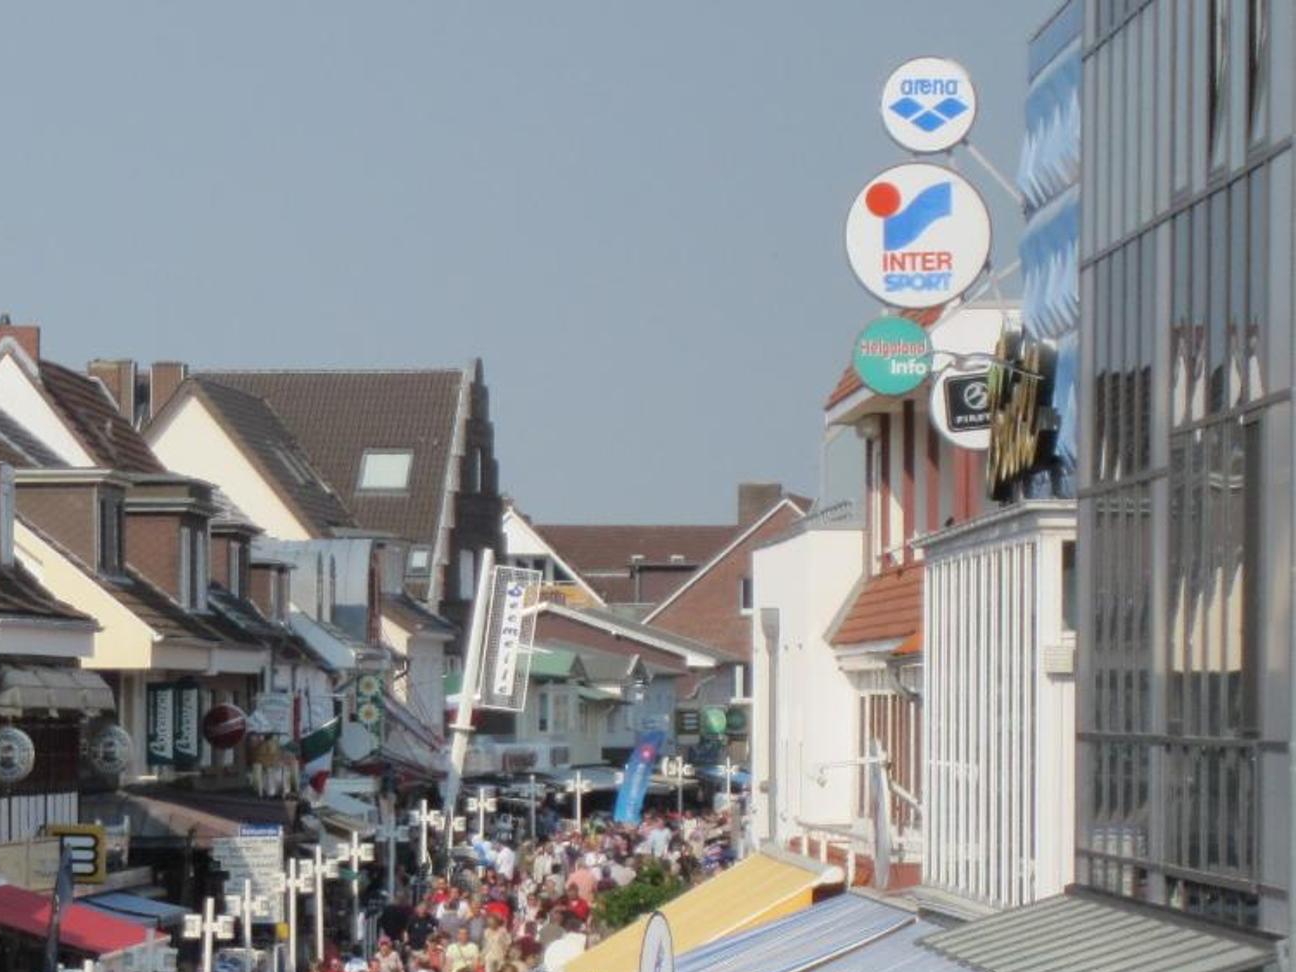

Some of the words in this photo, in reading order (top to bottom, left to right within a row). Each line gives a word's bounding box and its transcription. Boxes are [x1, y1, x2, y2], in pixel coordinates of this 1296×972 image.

[900, 79, 958, 96] arena
[882, 252, 953, 272] INTER
[884, 273, 952, 293] SPORT
[860, 336, 927, 359] Helgoland
[890, 359, 927, 375] Info
